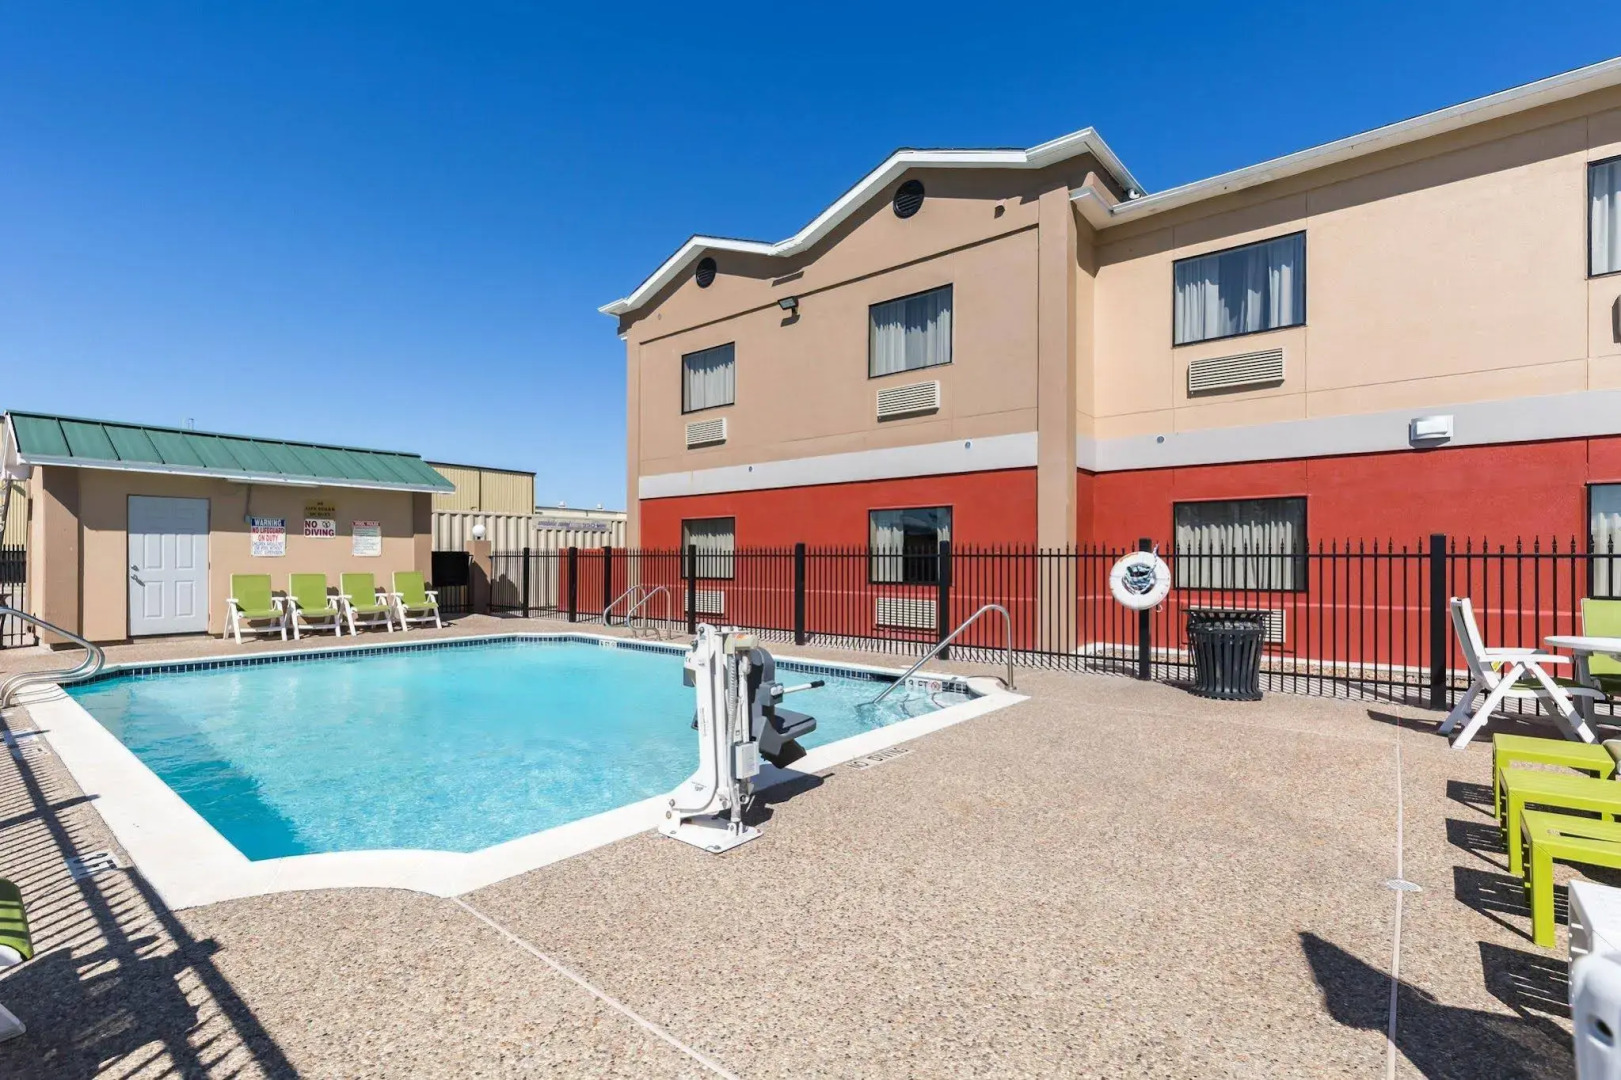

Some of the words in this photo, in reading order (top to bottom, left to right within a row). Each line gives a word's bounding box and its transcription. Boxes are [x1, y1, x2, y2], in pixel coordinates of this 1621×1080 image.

[254, 518, 282, 527] WARNING
[304, 520, 318, 528] NO
[304, 528, 335, 536] DIVING
